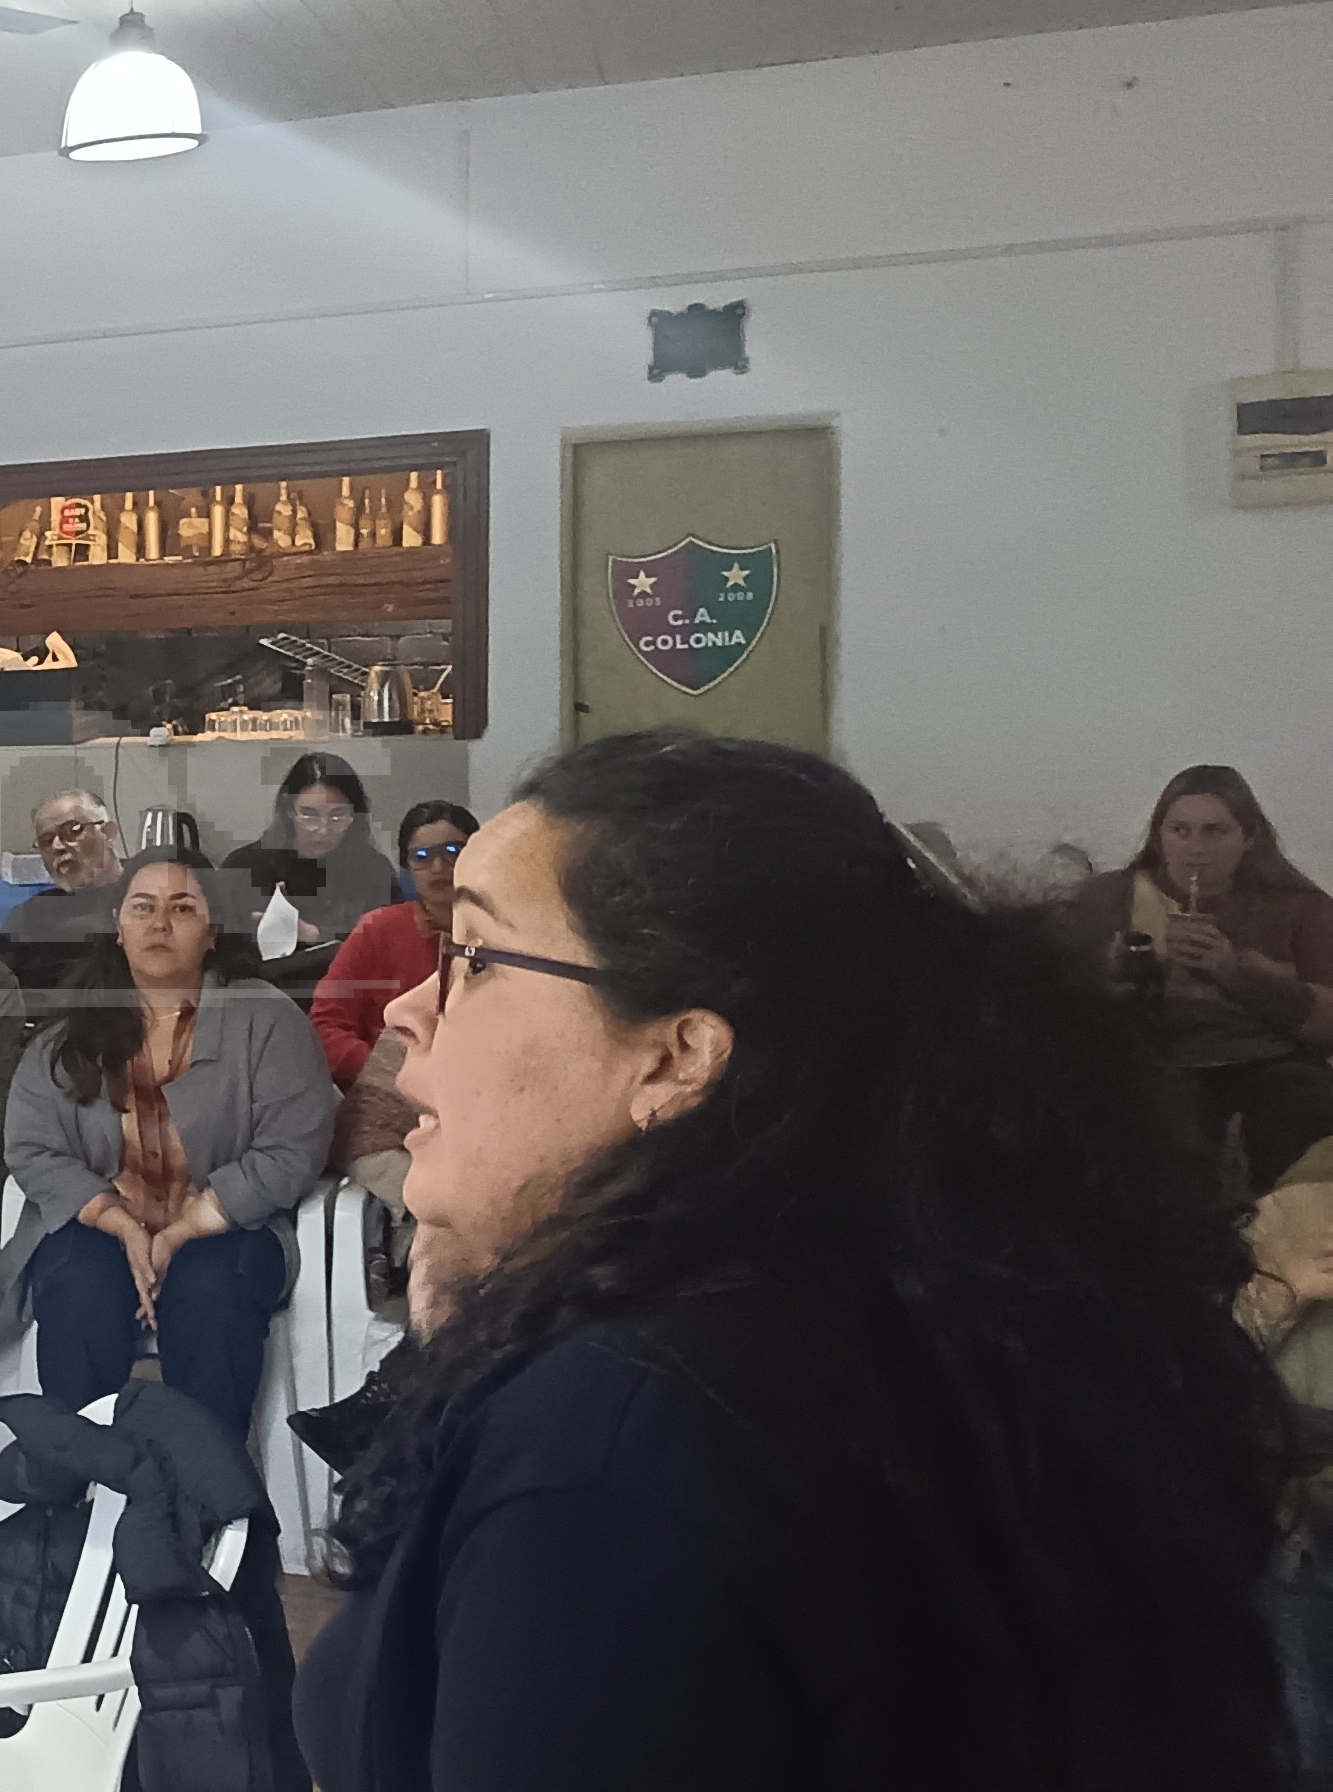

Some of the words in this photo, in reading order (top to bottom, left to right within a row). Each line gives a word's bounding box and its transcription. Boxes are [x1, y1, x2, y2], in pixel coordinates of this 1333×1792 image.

[666, 608, 691, 626] C.
[694, 607, 718, 625] A.
[638, 629, 747, 652] COLONIA
